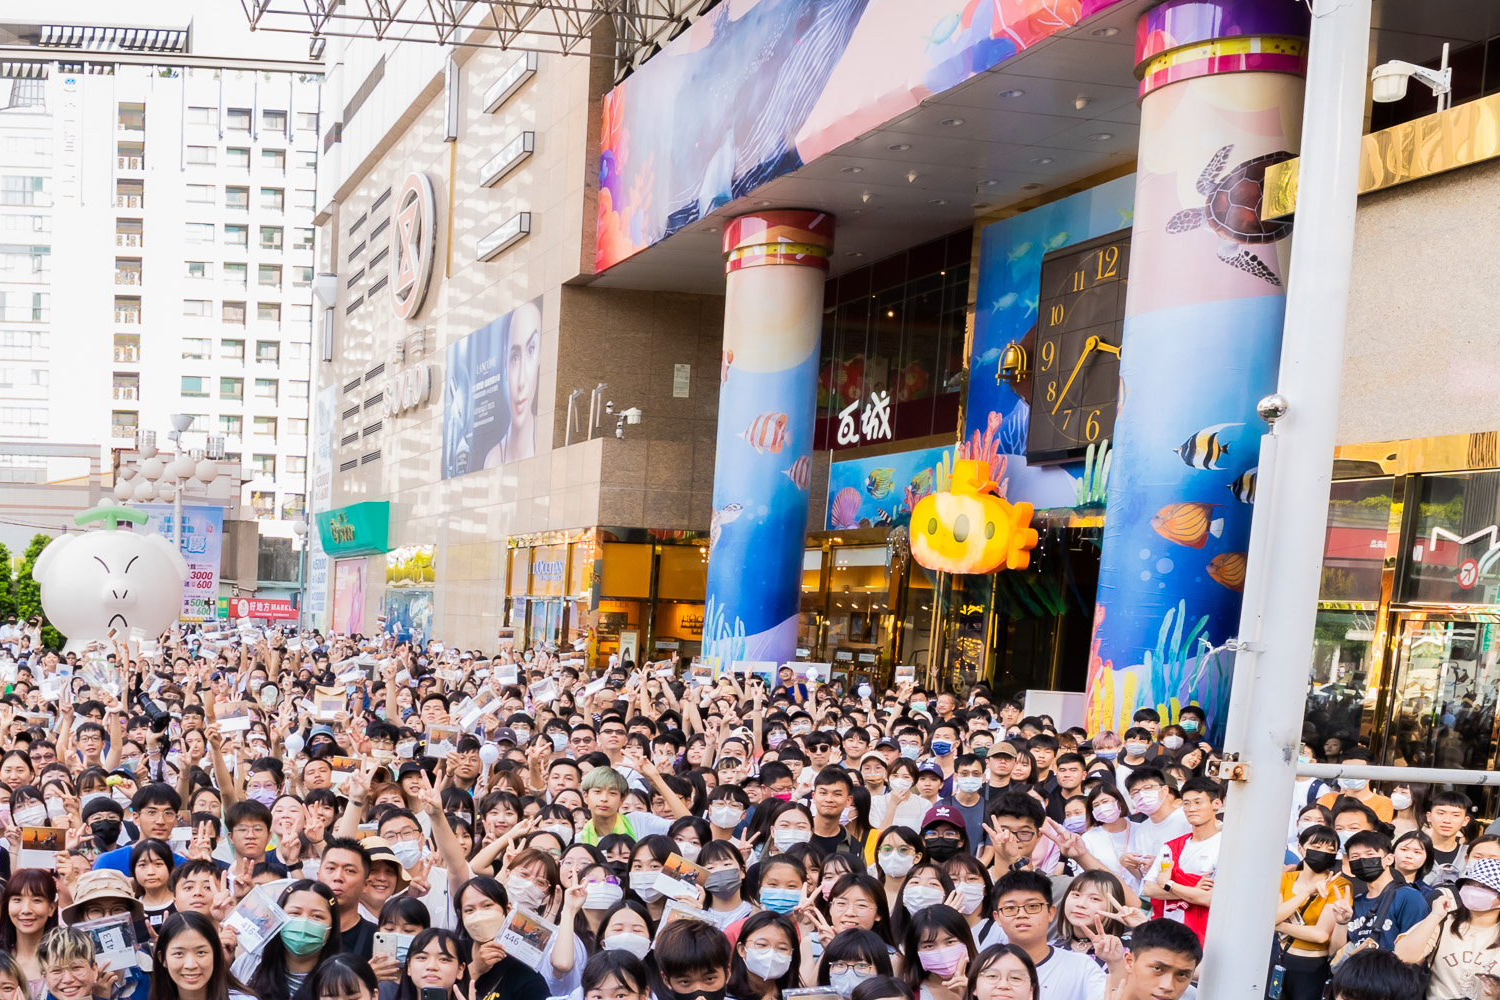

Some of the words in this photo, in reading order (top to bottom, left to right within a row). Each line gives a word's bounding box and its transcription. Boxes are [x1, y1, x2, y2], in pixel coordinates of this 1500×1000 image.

[1096, 246, 1119, 280] 12
[1073, 270, 1086, 292] 11
[1050, 304, 1065, 327] 10
[1041, 341, 1055, 371] 9
[382, 365, 423, 418] SOGO
[1046, 381, 1057, 402] 8
[837, 390, 892, 446] 瓦城
[1062, 409, 1073, 431] 7
[1085, 410, 1101, 441] 6
[190, 571, 213, 580] 3000
[197, 581, 213, 589] 600
[103, 932, 114, 950] 413
[503, 933, 520, 946] 446
[1442, 950, 1498, 974] UCLA
